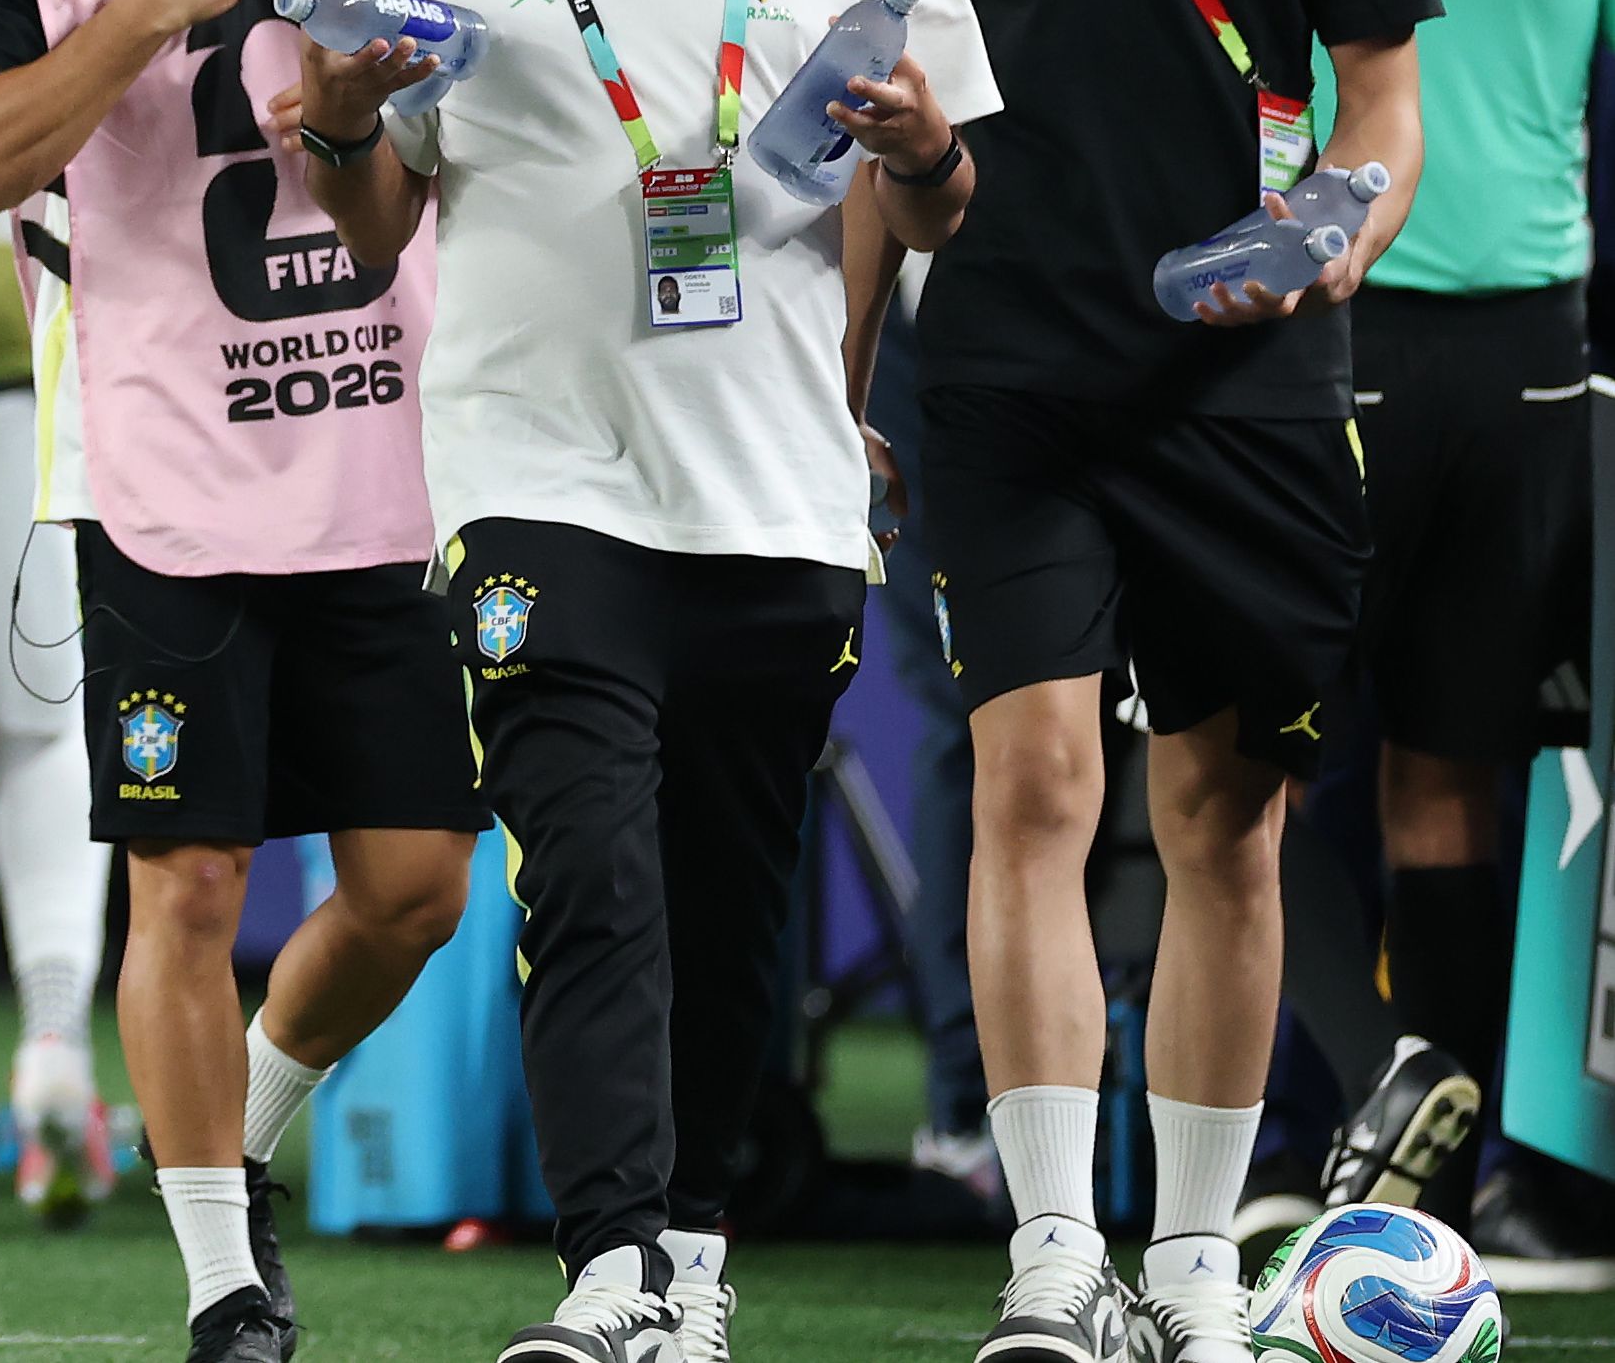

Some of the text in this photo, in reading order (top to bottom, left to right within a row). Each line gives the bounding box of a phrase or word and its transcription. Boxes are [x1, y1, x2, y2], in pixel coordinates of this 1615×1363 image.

[264, 244, 357, 293] FIFA
[220, 324, 404, 370] WORLD CUP
[225, 360, 405, 423] 2026
[491, 617, 512, 626] CBF
[119, 783, 181, 800] BRASIL
